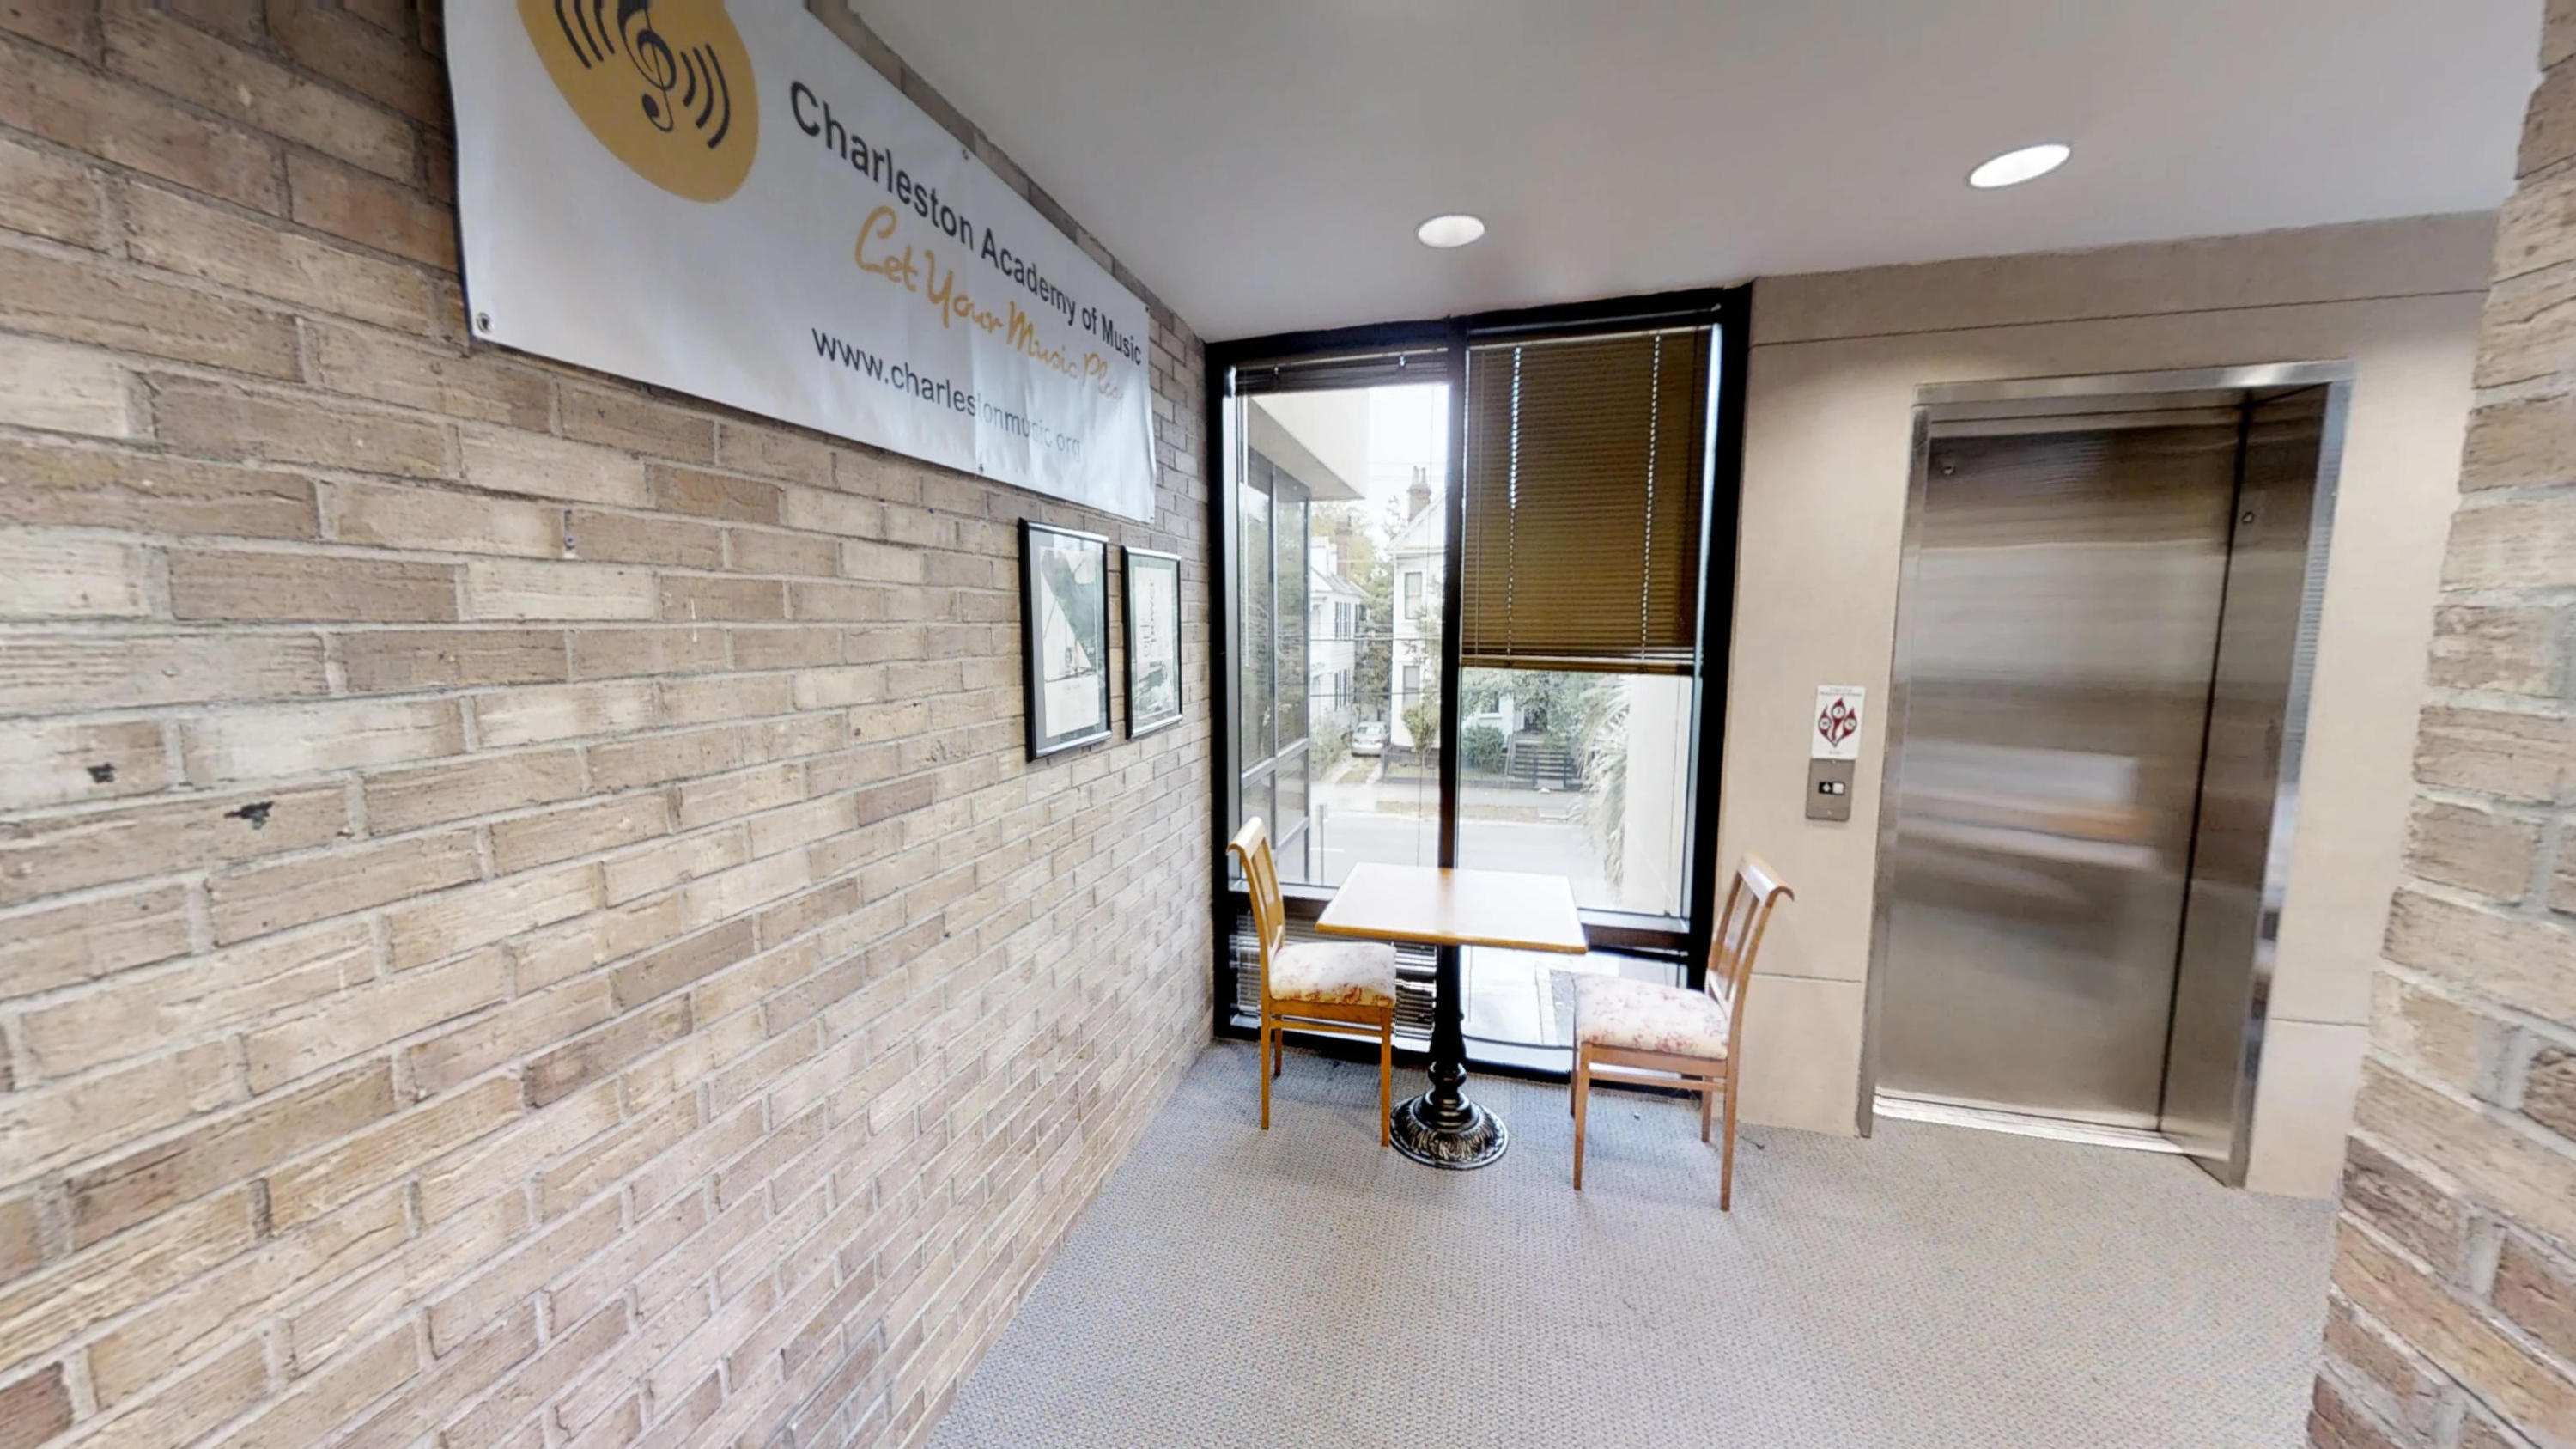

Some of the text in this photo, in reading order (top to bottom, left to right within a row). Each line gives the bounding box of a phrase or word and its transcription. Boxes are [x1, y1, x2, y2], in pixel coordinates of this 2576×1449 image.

[791, 81, 1142, 366] Charleston Academy of Music
[854, 205, 919, 293] Let
[925, 249, 1004, 333] Your
[1006, 300, 1078, 379] Music
[811, 327, 1080, 463] www.charlestonmusicorg
